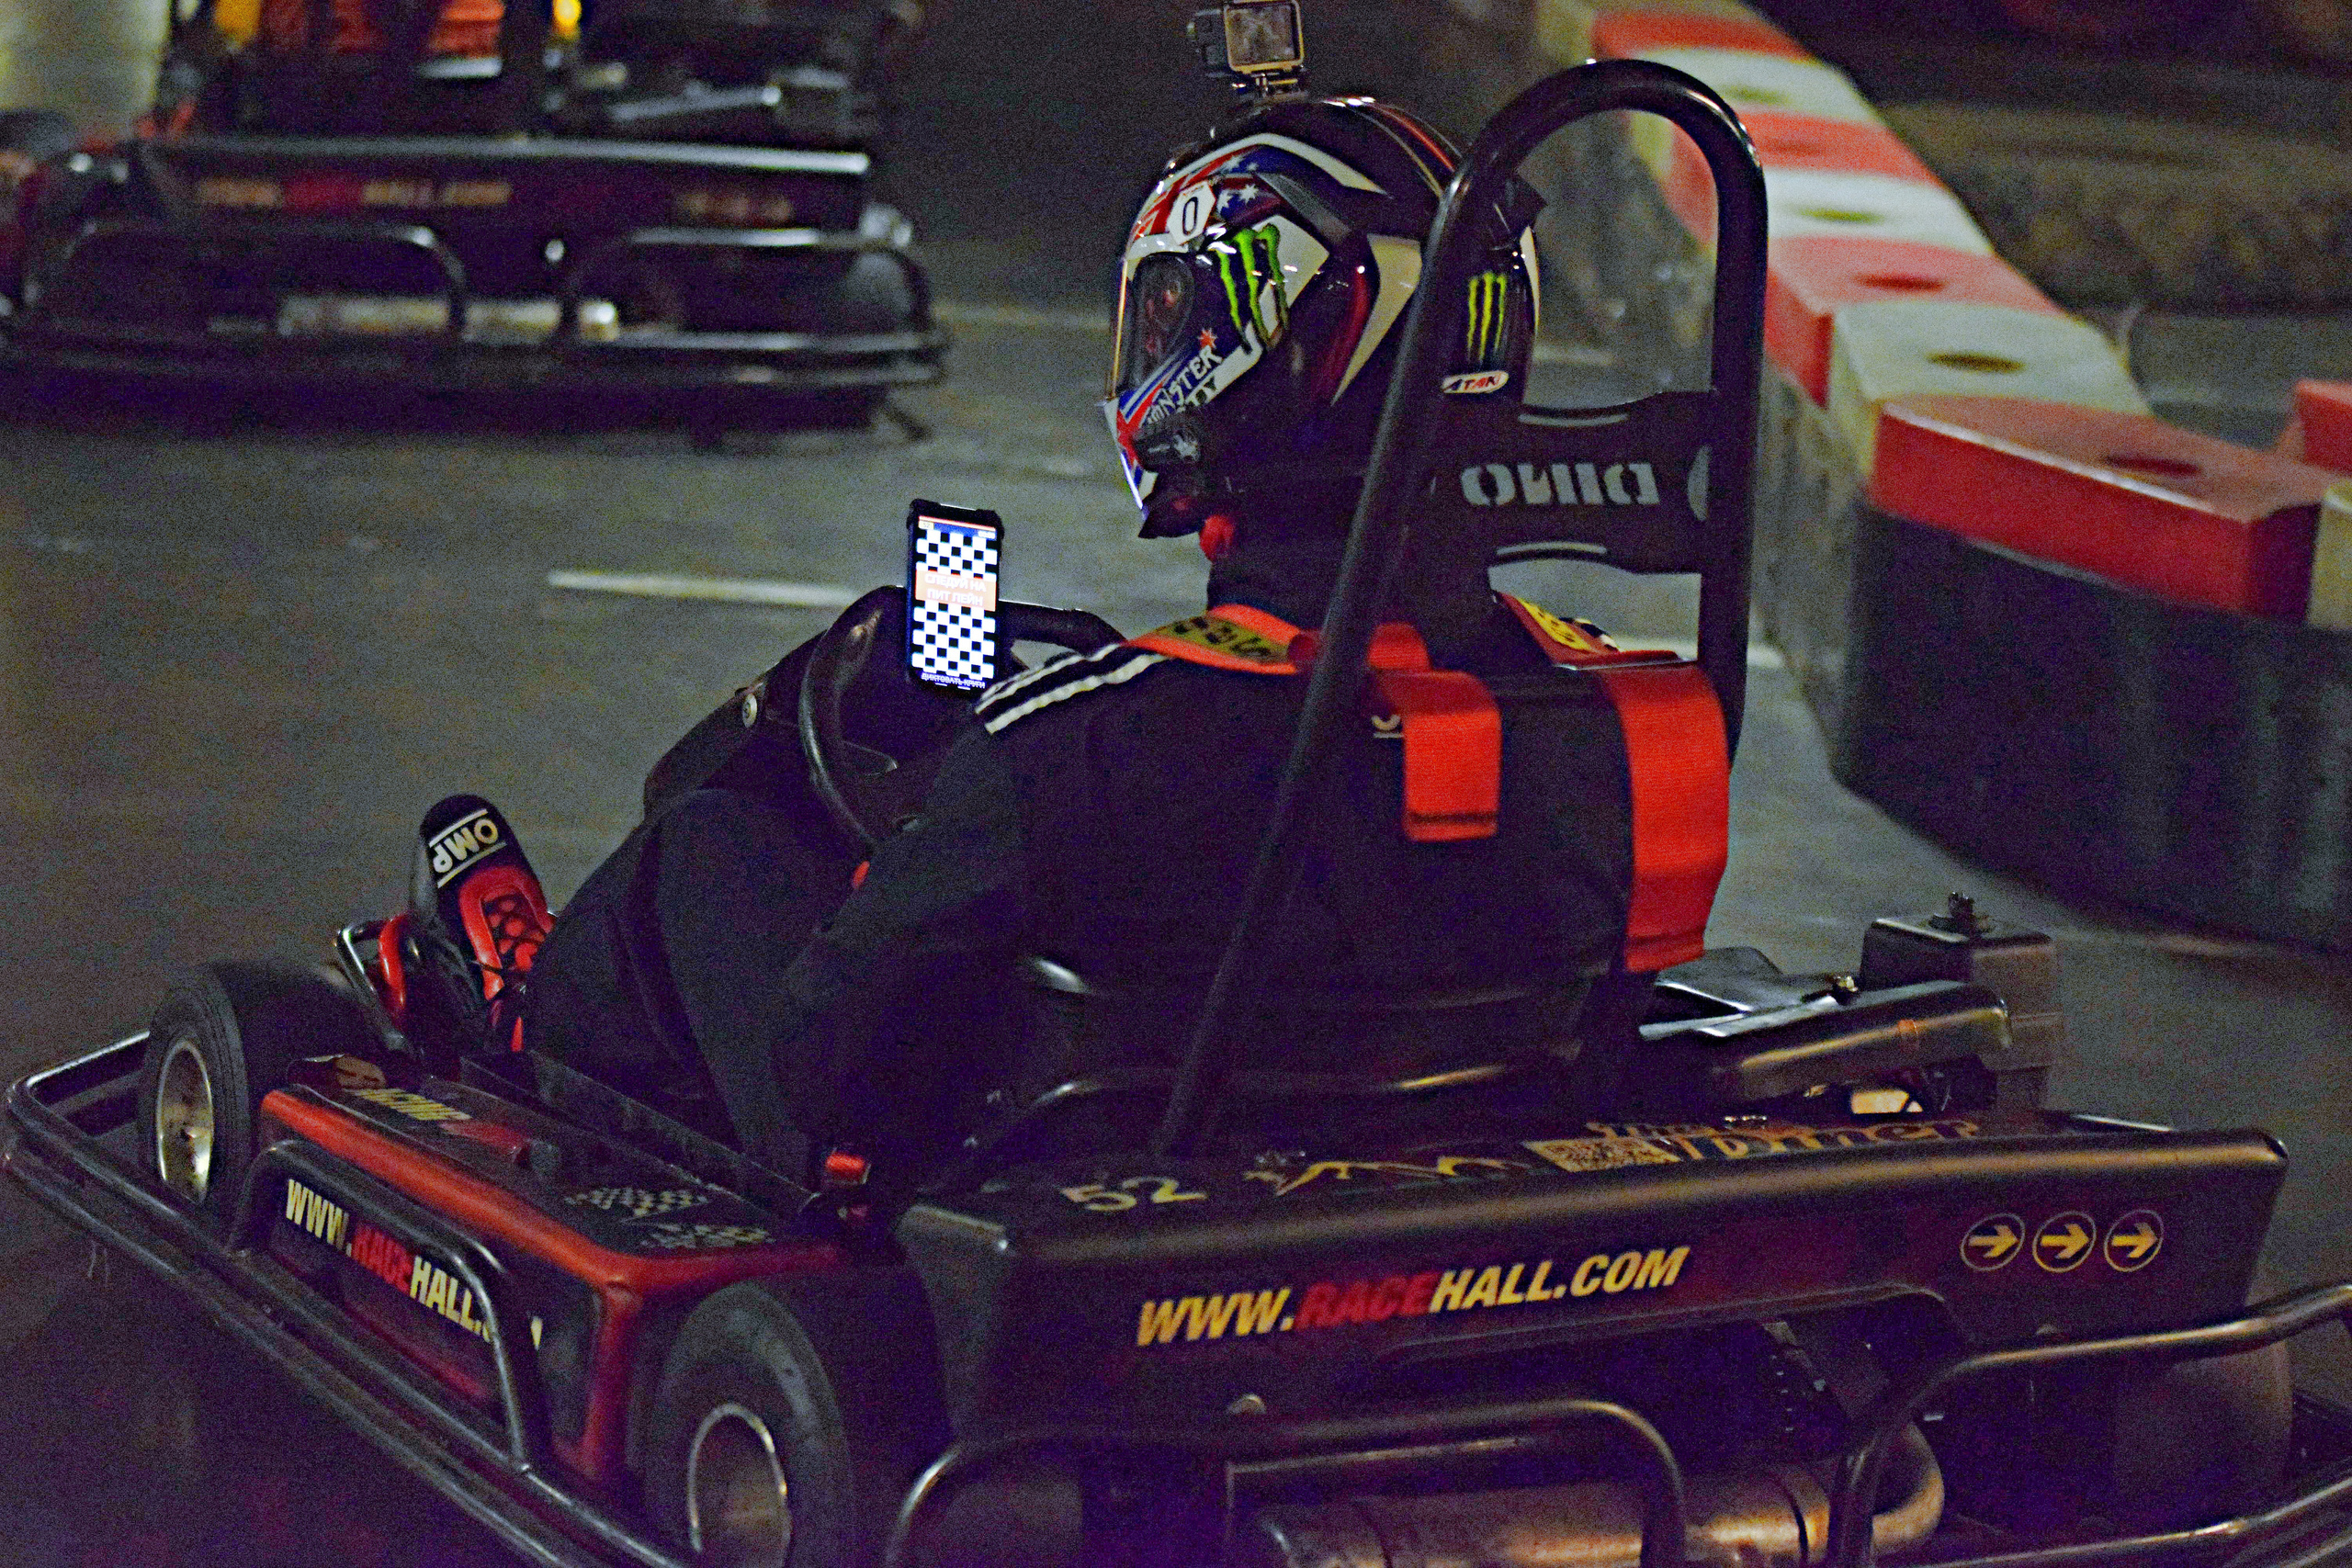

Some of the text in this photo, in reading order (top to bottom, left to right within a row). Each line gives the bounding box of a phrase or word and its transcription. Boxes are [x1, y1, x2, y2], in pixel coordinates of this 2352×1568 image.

[924, 574, 987, 592] СЛЕДУЙ НА
[927, 588, 984, 606] ПИТ ЛЕЙН
[433, 818, 499, 874] OMP
[1060, 1176, 1209, 1213] 52
[1136, 1246, 1691, 1347] WWW.RACEHALL.COM
